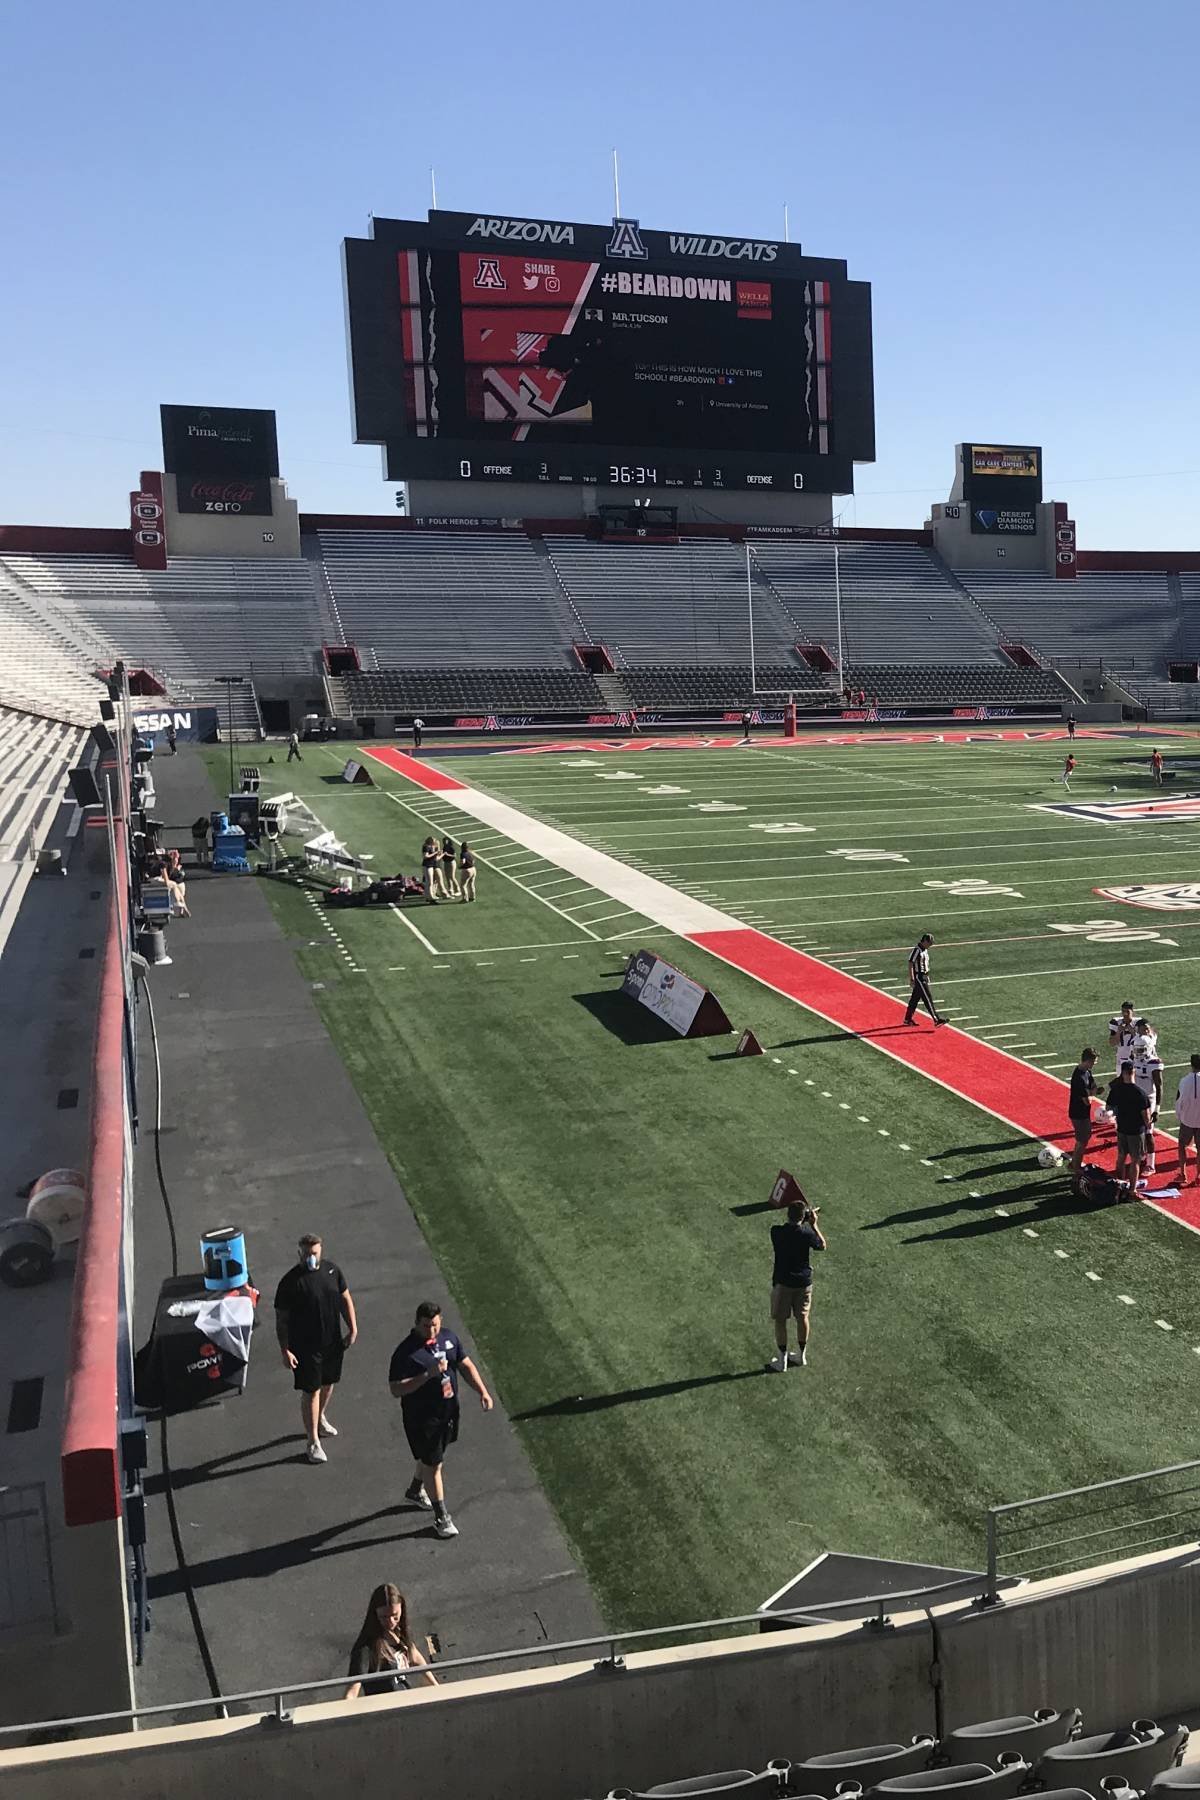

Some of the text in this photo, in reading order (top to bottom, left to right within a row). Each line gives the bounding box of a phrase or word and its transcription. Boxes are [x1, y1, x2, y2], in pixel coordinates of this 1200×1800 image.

[466, 217, 779, 262] ARIZONA A WILDCATS
[473, 258, 556, 290] A SHARE
[601, 272, 732, 302] #BEARDOWN
[738, 292, 769, 301] WELLS
[697, 367, 720, 375] MUCH
[726, 368, 745, 377] LOVE
[187, 424, 219, 437] Pima
[460, 460, 471, 477] 0
[483, 465, 512, 475] OFFENSE
[609, 466, 657, 483] 36:34
[747, 475, 773, 485] DEFENSE
[794, 473, 803, 489] 0
[205, 501, 241, 512] zero
[946, 507, 959, 518] 40
[415, 518, 424, 526] 11
[450, 518, 479, 526] HEROES
[998, 523, 1034, 531] CASINOS
[263, 533, 274, 542] 10
[922, 878, 1014, 896] 30
[1046, 919, 1162, 943] 20
[773, 1177, 787, 1203] G
